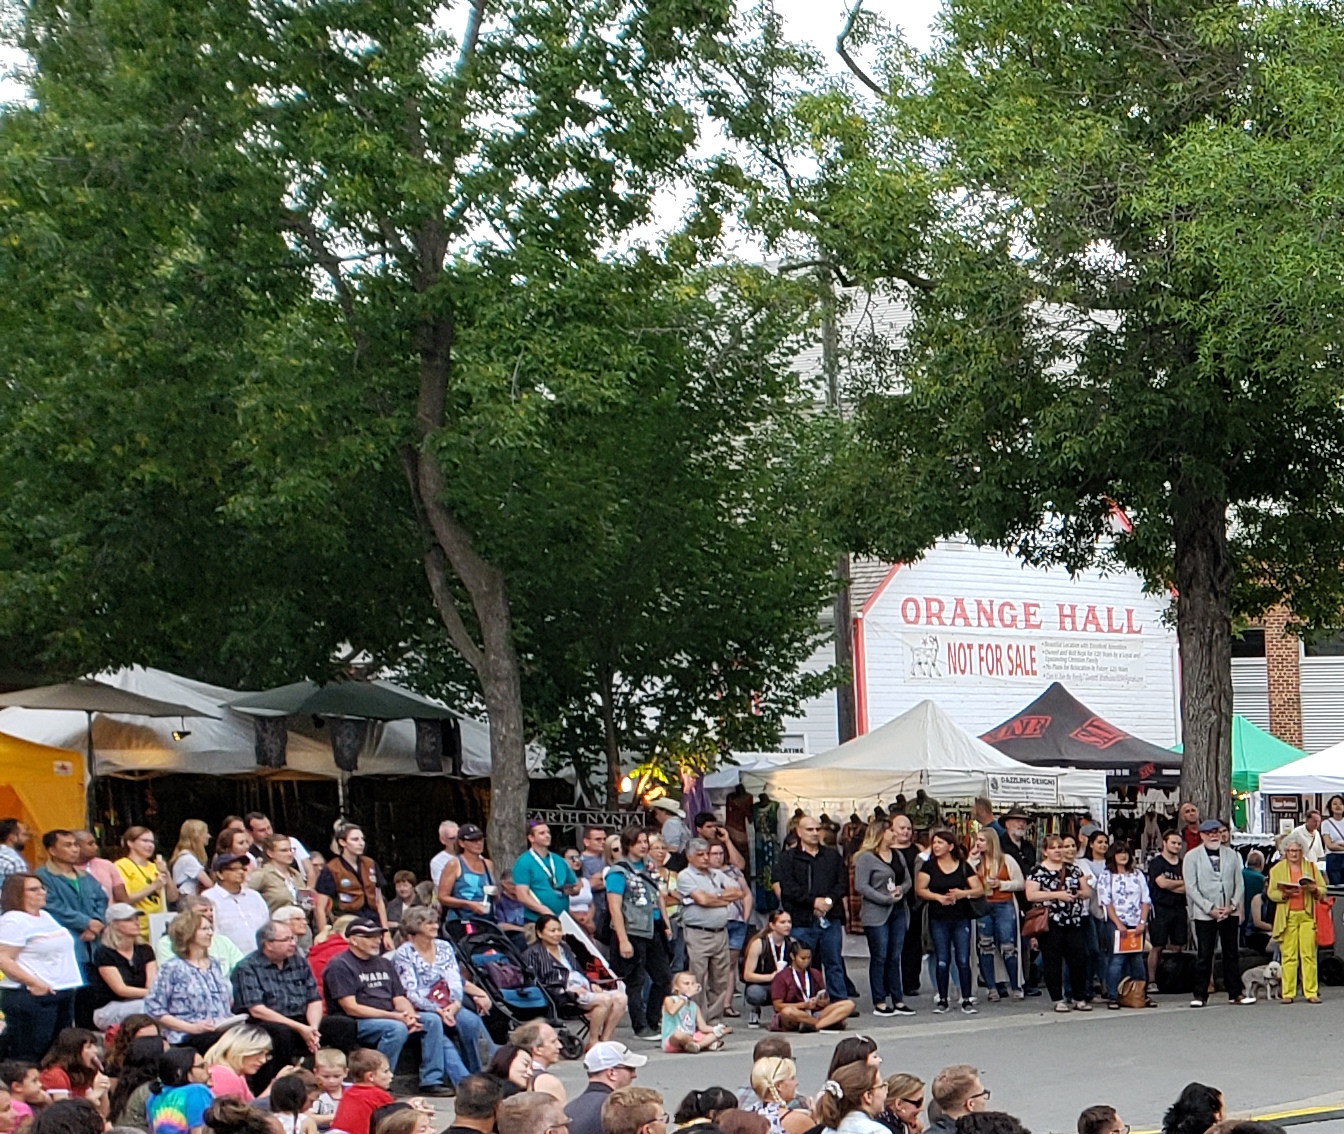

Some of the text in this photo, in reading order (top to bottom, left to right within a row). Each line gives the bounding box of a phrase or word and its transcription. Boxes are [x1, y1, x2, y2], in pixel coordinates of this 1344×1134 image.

[901, 596, 1143, 635] ORANGE HALL
[947, 641, 1038, 677] NOT FOR SALE
[1001, 776, 1031, 784] DAZZLING
